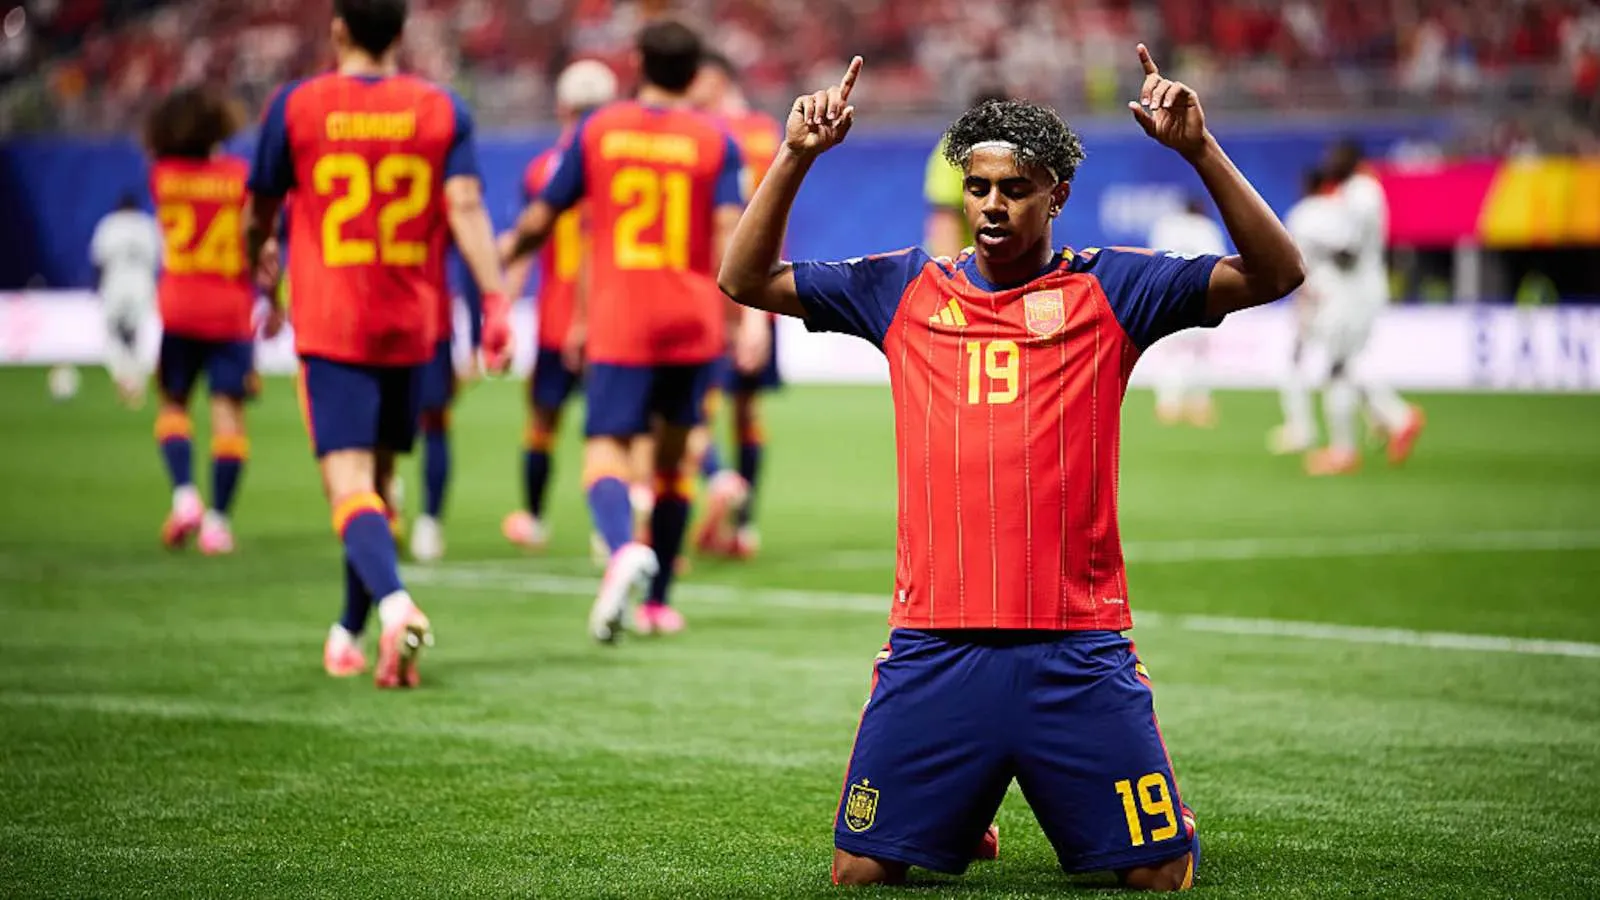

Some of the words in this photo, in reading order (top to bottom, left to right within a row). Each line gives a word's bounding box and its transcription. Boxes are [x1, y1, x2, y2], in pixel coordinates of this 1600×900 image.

[159, 201, 240, 276] 24
[313, 153, 432, 267] 22
[611, 166, 691, 270] 21
[966, 340, 1020, 405] 19
[1115, 772, 1178, 846] 19
